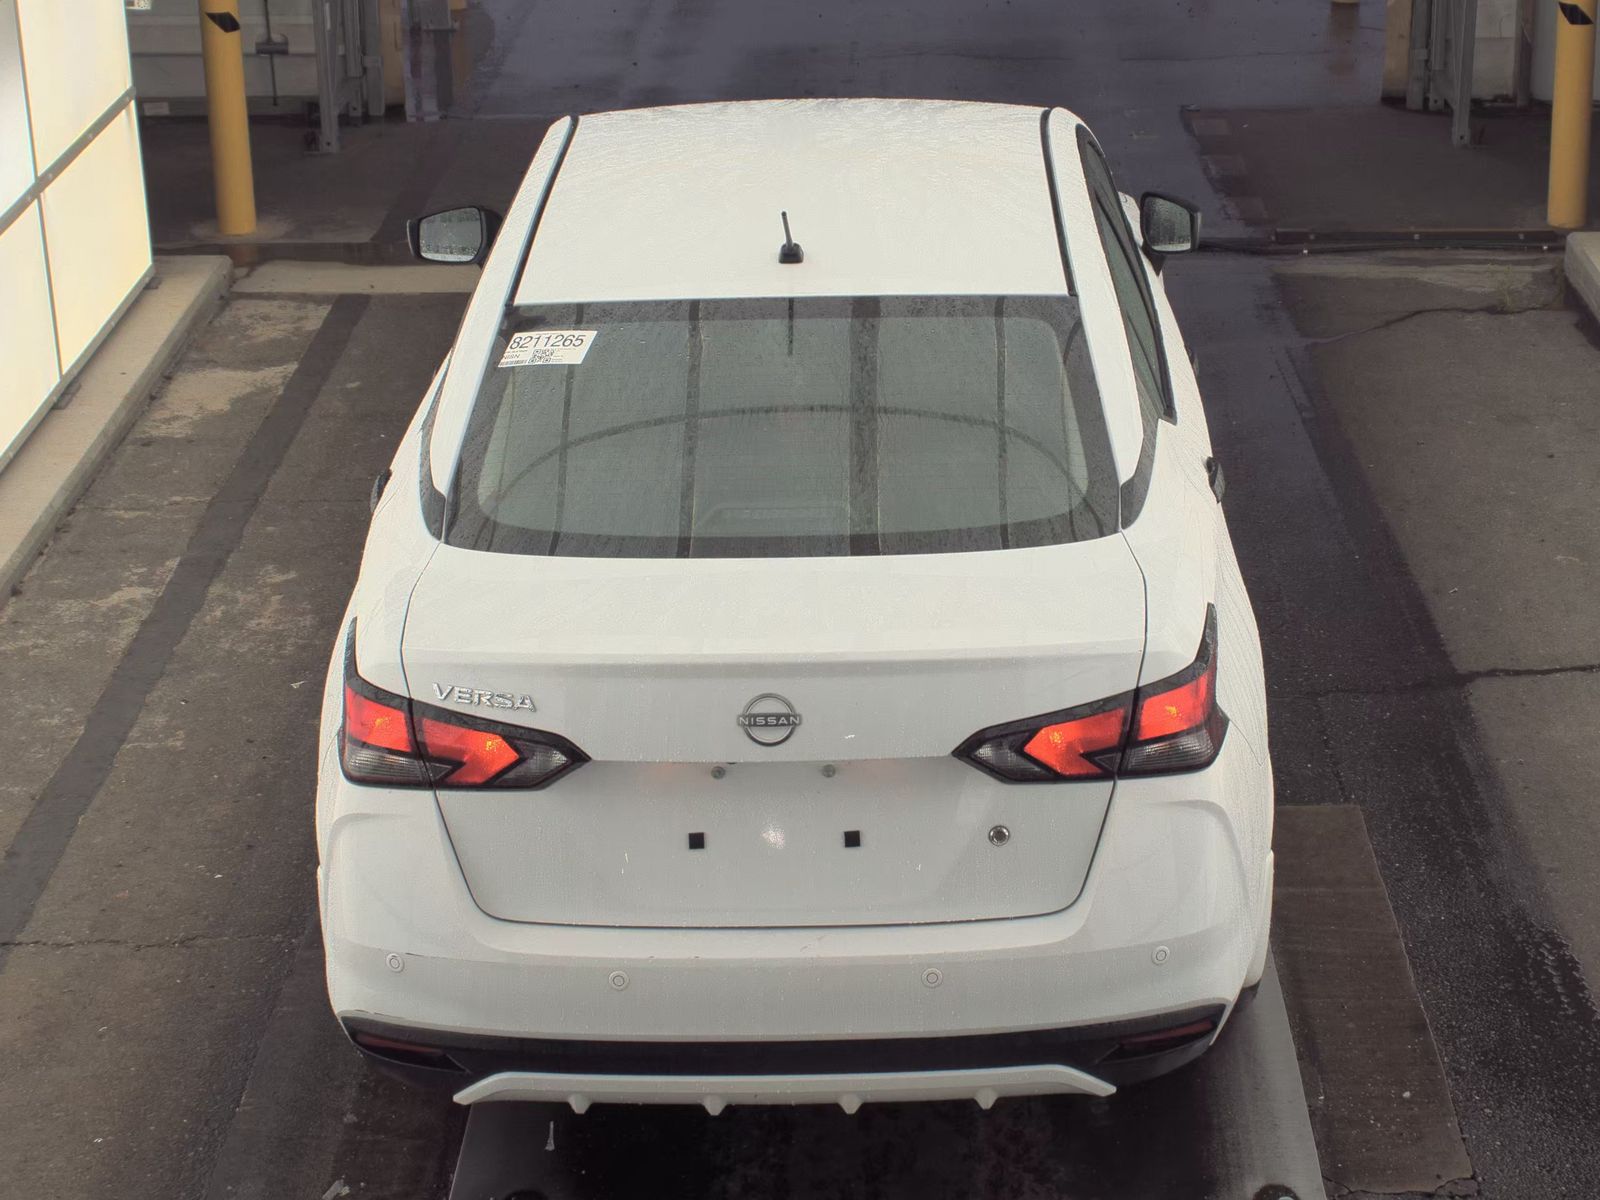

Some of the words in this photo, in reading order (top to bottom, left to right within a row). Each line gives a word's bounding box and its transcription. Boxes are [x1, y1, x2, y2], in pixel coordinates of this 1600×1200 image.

[510, 334, 586, 350] 8211265
[432, 682, 536, 712] VERSA
[739, 716, 800, 725] NISSAN
